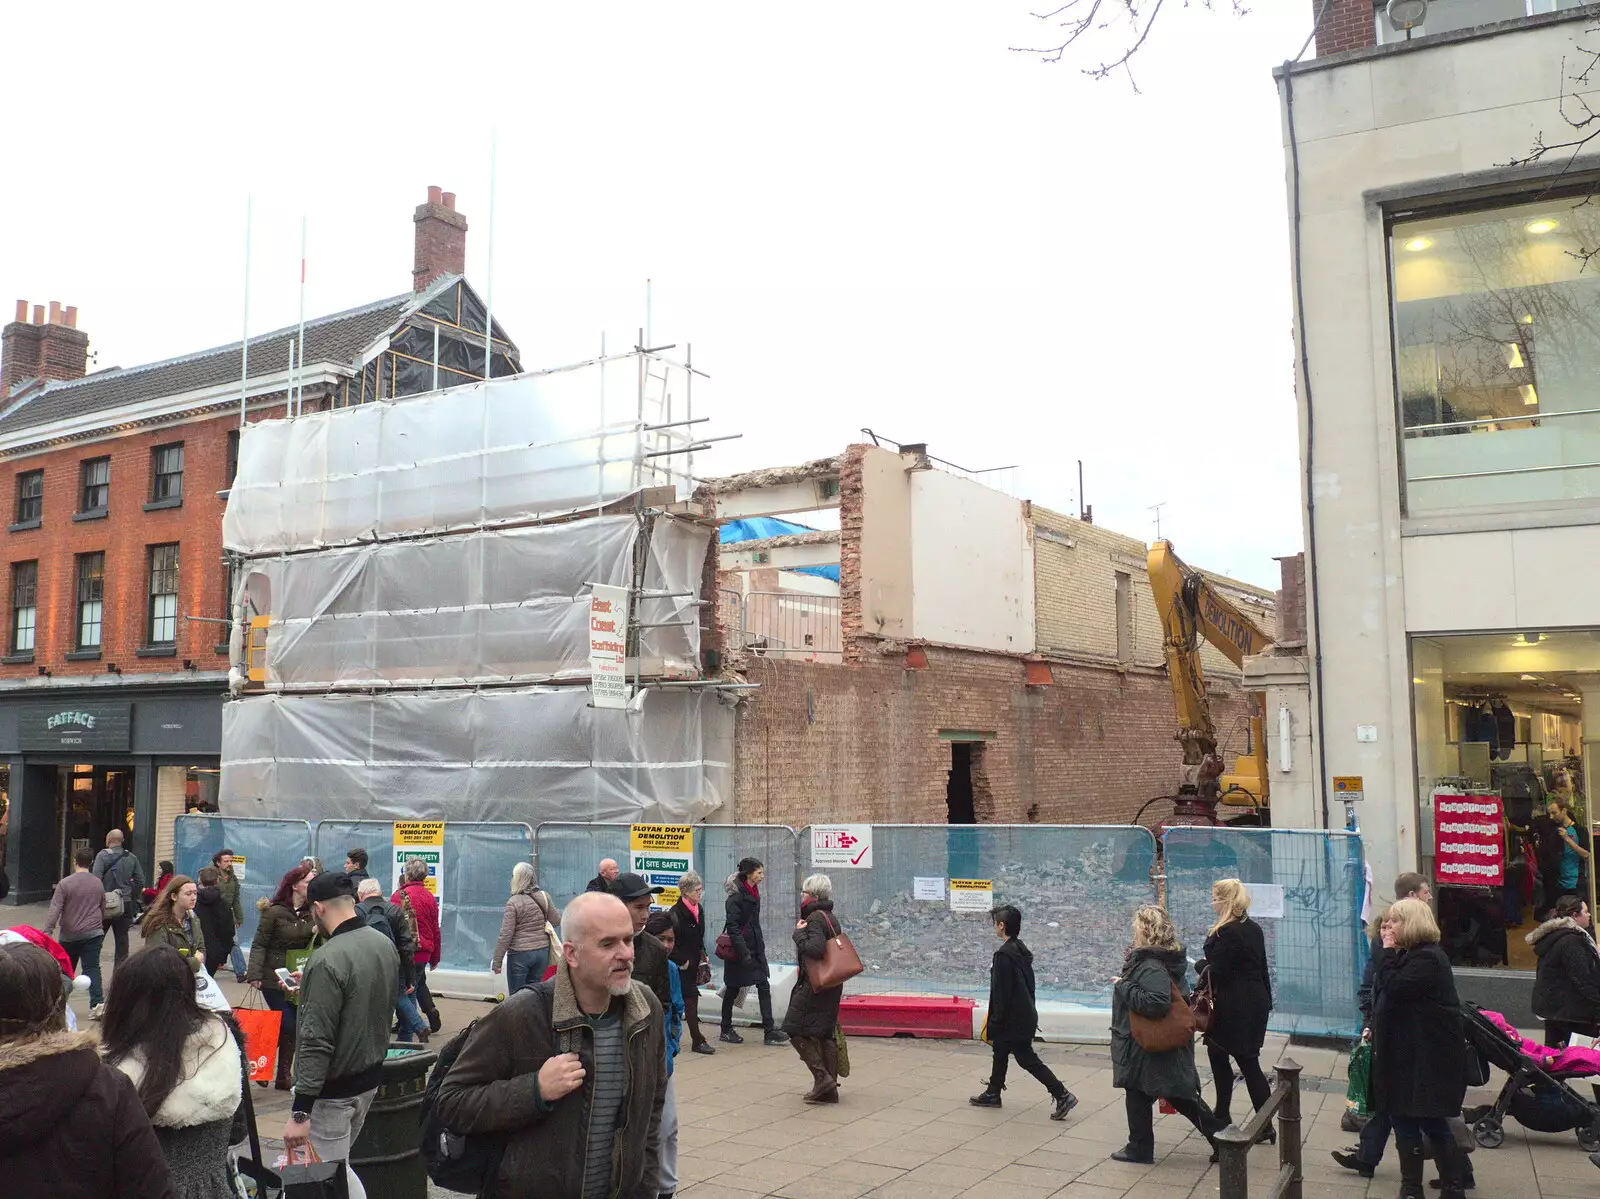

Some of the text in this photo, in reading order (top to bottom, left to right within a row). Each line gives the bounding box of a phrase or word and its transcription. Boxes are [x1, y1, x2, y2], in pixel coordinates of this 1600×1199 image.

[1205, 600, 1252, 656] DEMOLITION
[47, 711, 96, 730] FATFACE
[1440, 803, 1497, 814] REDUCTIONS
[1440, 824, 1498, 834] REDUCTIONS
[814, 832, 843, 848] NFDC
[1441, 844, 1498, 855] REDUCTIONS
[662, 861, 686, 869] SAFETY
[1442, 864, 1499, 875] REDUCTIONS
